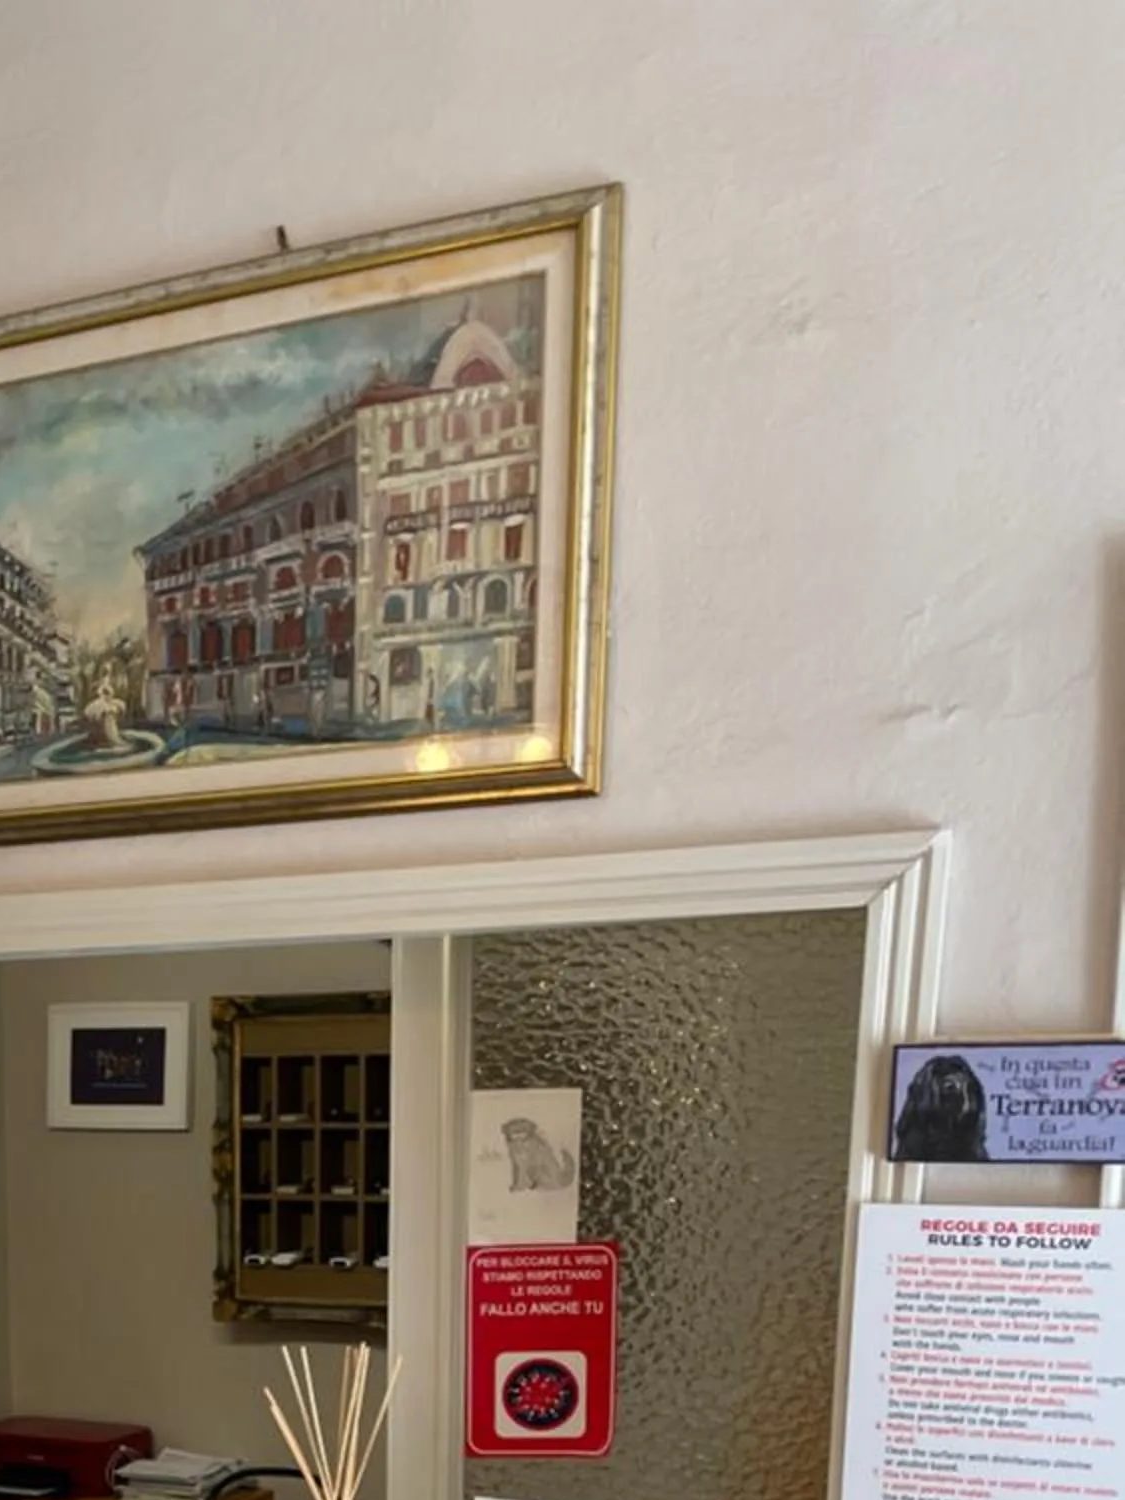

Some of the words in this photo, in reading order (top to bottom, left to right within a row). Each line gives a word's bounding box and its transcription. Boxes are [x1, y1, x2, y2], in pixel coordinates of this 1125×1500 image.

[1001, 1057, 1020, 1073] In
[1024, 1058, 1090, 1076] questa
[989, 1093, 1125, 1116] Terranova
[920, 1219, 988, 1234] REGOLE
[994, 1221, 1018, 1234] DA
[1024, 1222, 1101, 1236] SEGUIRE
[928, 1234, 983, 1248] RULES
[989, 1236, 1011, 1248] TO
[1015, 1236, 1092, 1250] FOLLOW
[476, 1257, 499, 1267] PER
[500, 1255, 559, 1267] BLOCCARE
[575, 1254, 608, 1266] VIRUS
[526, 1269, 602, 1281] RISPETTANDO
[511, 1286, 524, 1297] LE
[527, 1285, 572, 1296] REGOLE
[480, 1303, 526, 1317] FALLO
[529, 1302, 580, 1316] ANCHE
[585, 1302, 604, 1315] TU
